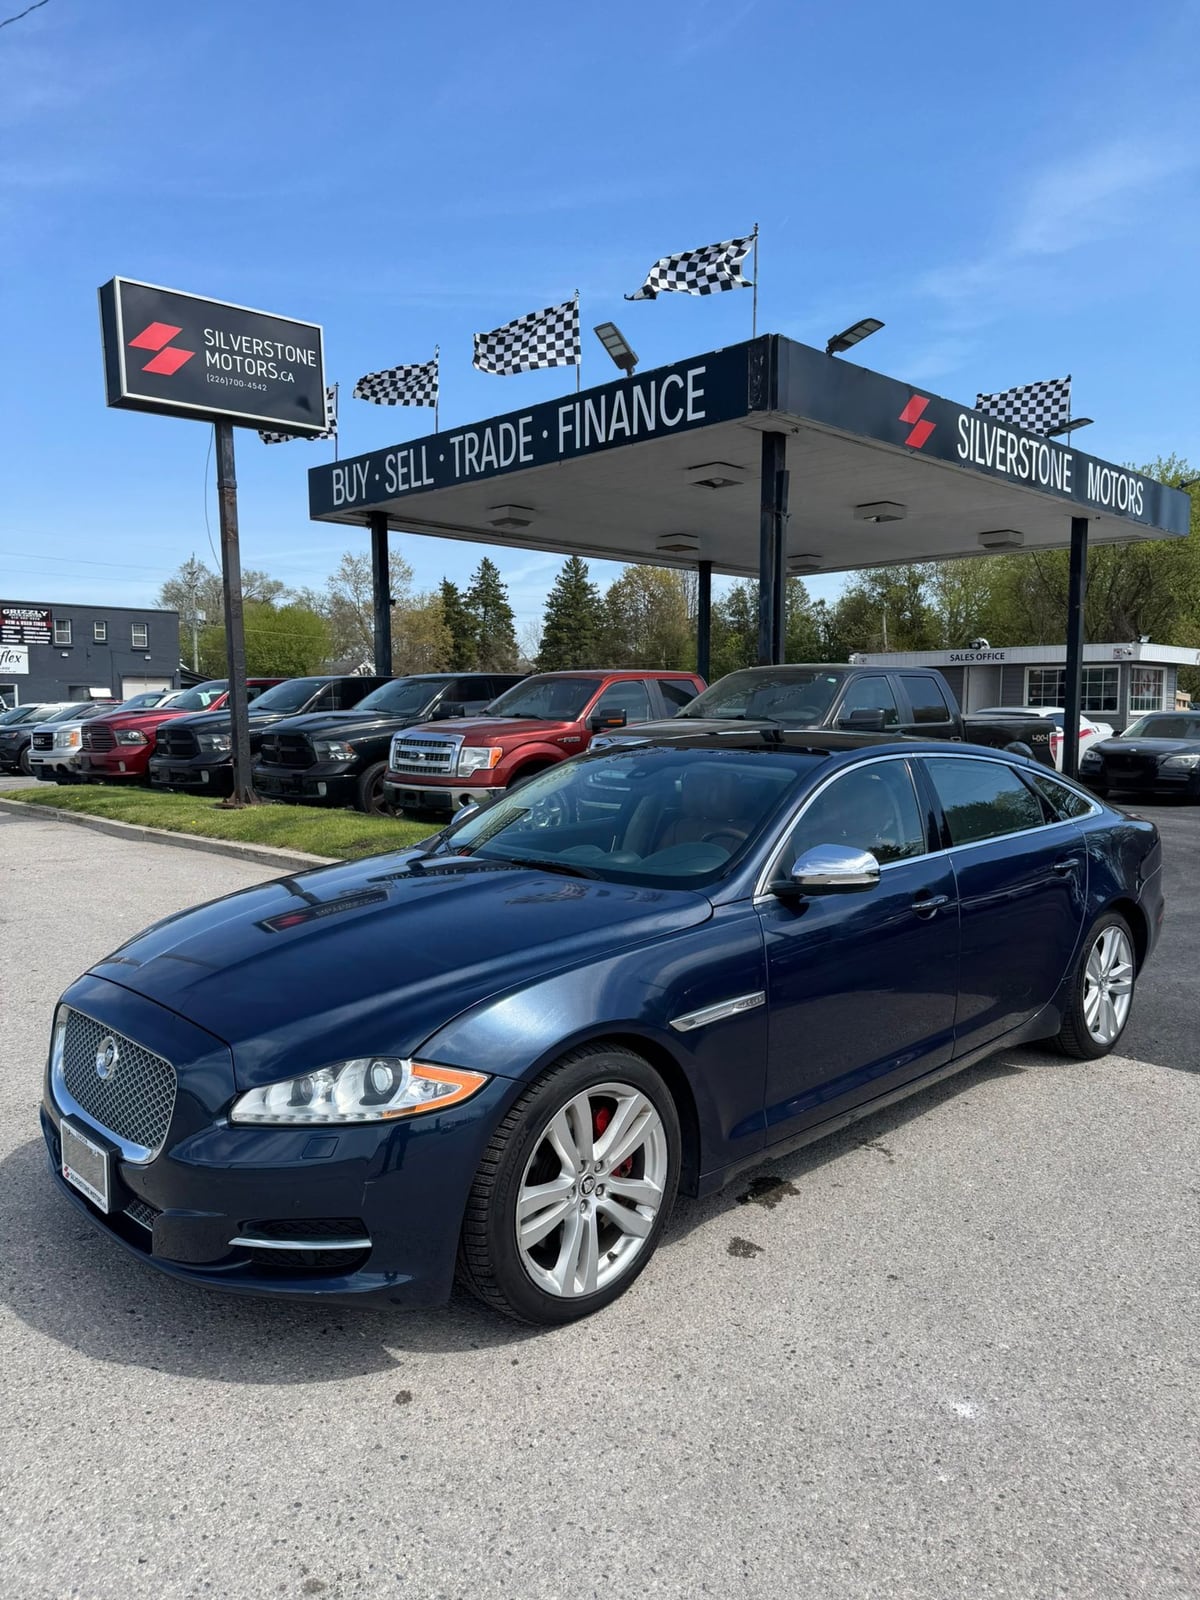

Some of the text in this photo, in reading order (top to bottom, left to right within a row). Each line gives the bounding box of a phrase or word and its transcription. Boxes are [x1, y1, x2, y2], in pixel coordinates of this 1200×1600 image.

[203, 328, 317, 368] SILVERSTONE
[205, 350, 295, 383] MOTORS.CA
[332, 366, 707, 506] BUY SELL TRADE FINANCE
[957, 413, 1144, 516] SILVERSTONE MOTORS
[2, 608, 48, 617] GRIZZLY
[950, 652, 1005, 662] SALES OFFICE
